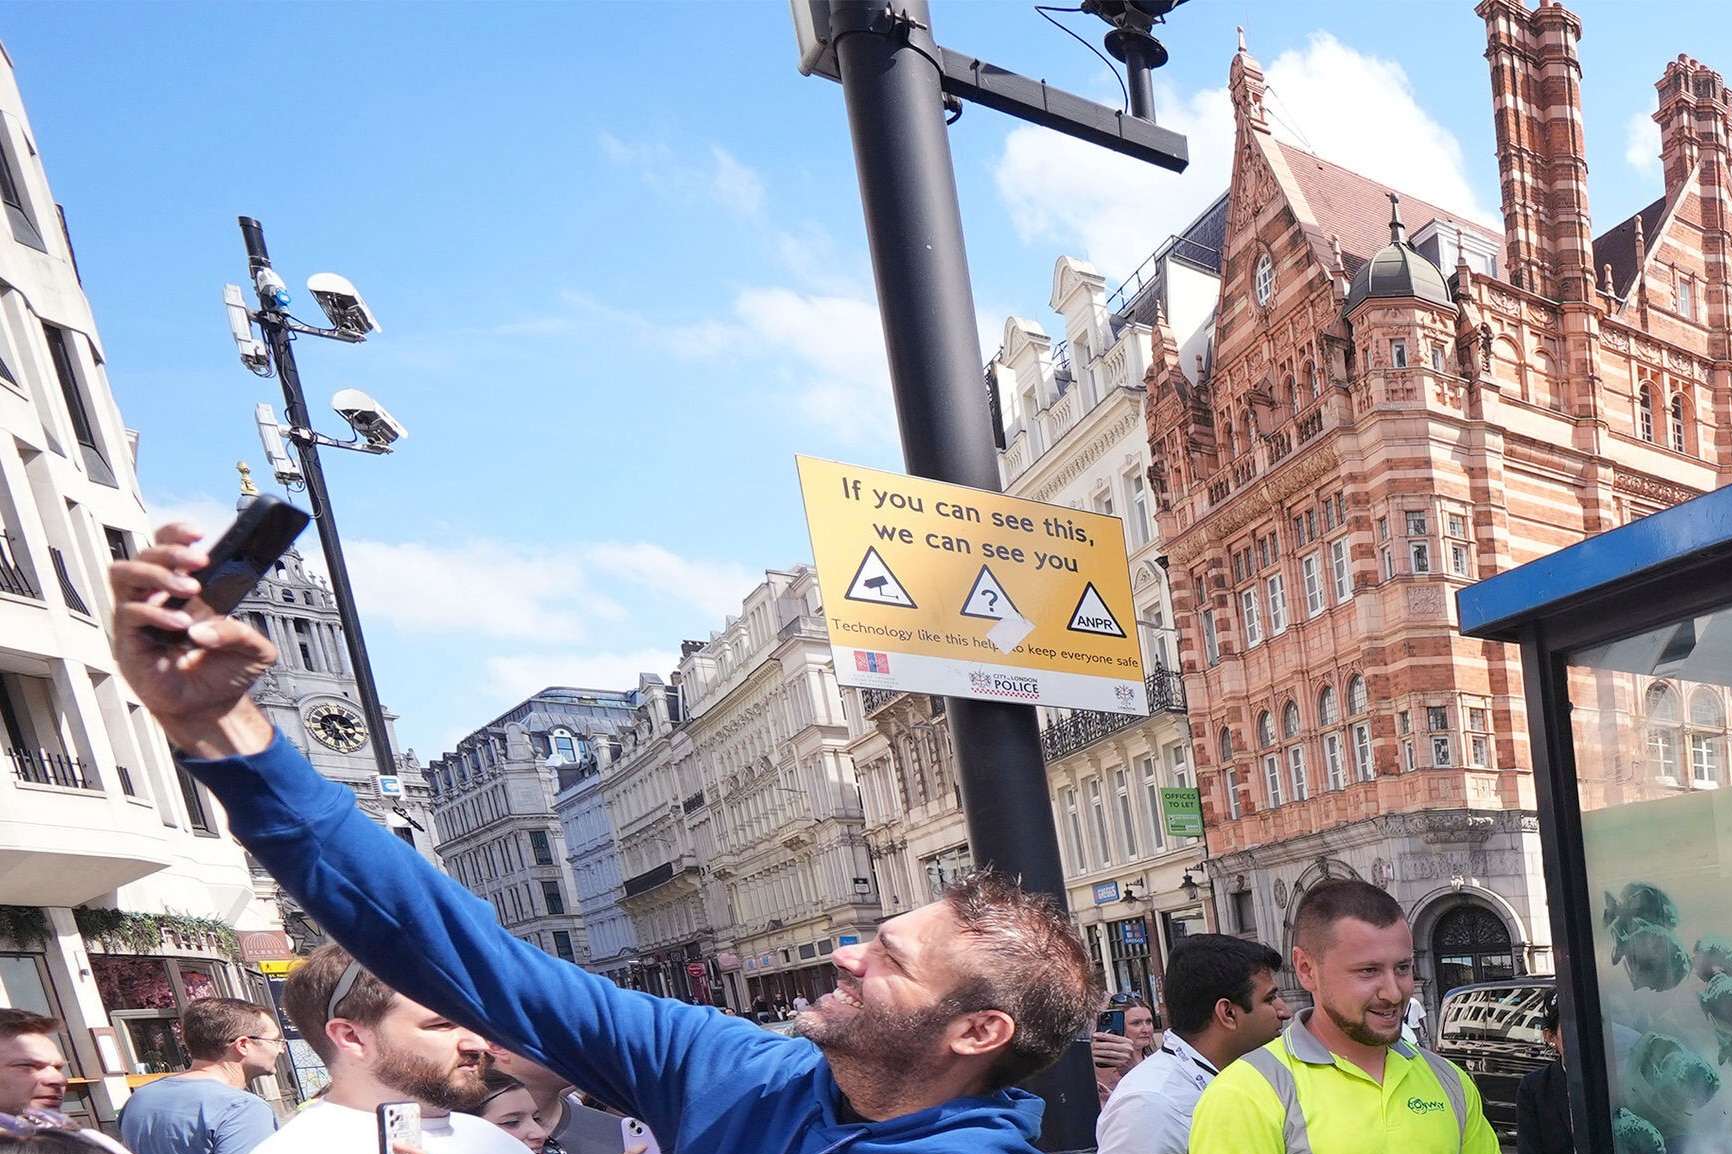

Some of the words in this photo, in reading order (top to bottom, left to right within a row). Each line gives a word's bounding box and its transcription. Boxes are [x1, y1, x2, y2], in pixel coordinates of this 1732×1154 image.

[842, 477, 861, 501] If
[872, 488, 924, 513] you
[936, 501, 981, 523] can
[992, 512, 1034, 533] see
[1043, 518, 1095, 547] this,
[873, 523, 914, 545] we
[925, 533, 971, 554] can
[981, 543, 1025, 563] see
[1034, 551, 1079, 573] you
[831, 618, 913, 641] Technology
[917, 629, 941, 643] like
[945, 634, 969, 647] this
[1028, 644, 1057, 659] keep
[1061, 650, 1113, 664] everyone
[1116, 657, 1139, 668] safe
[1077, 616, 1114, 631] ANPR
[994, 680, 1039, 694] POLICE
